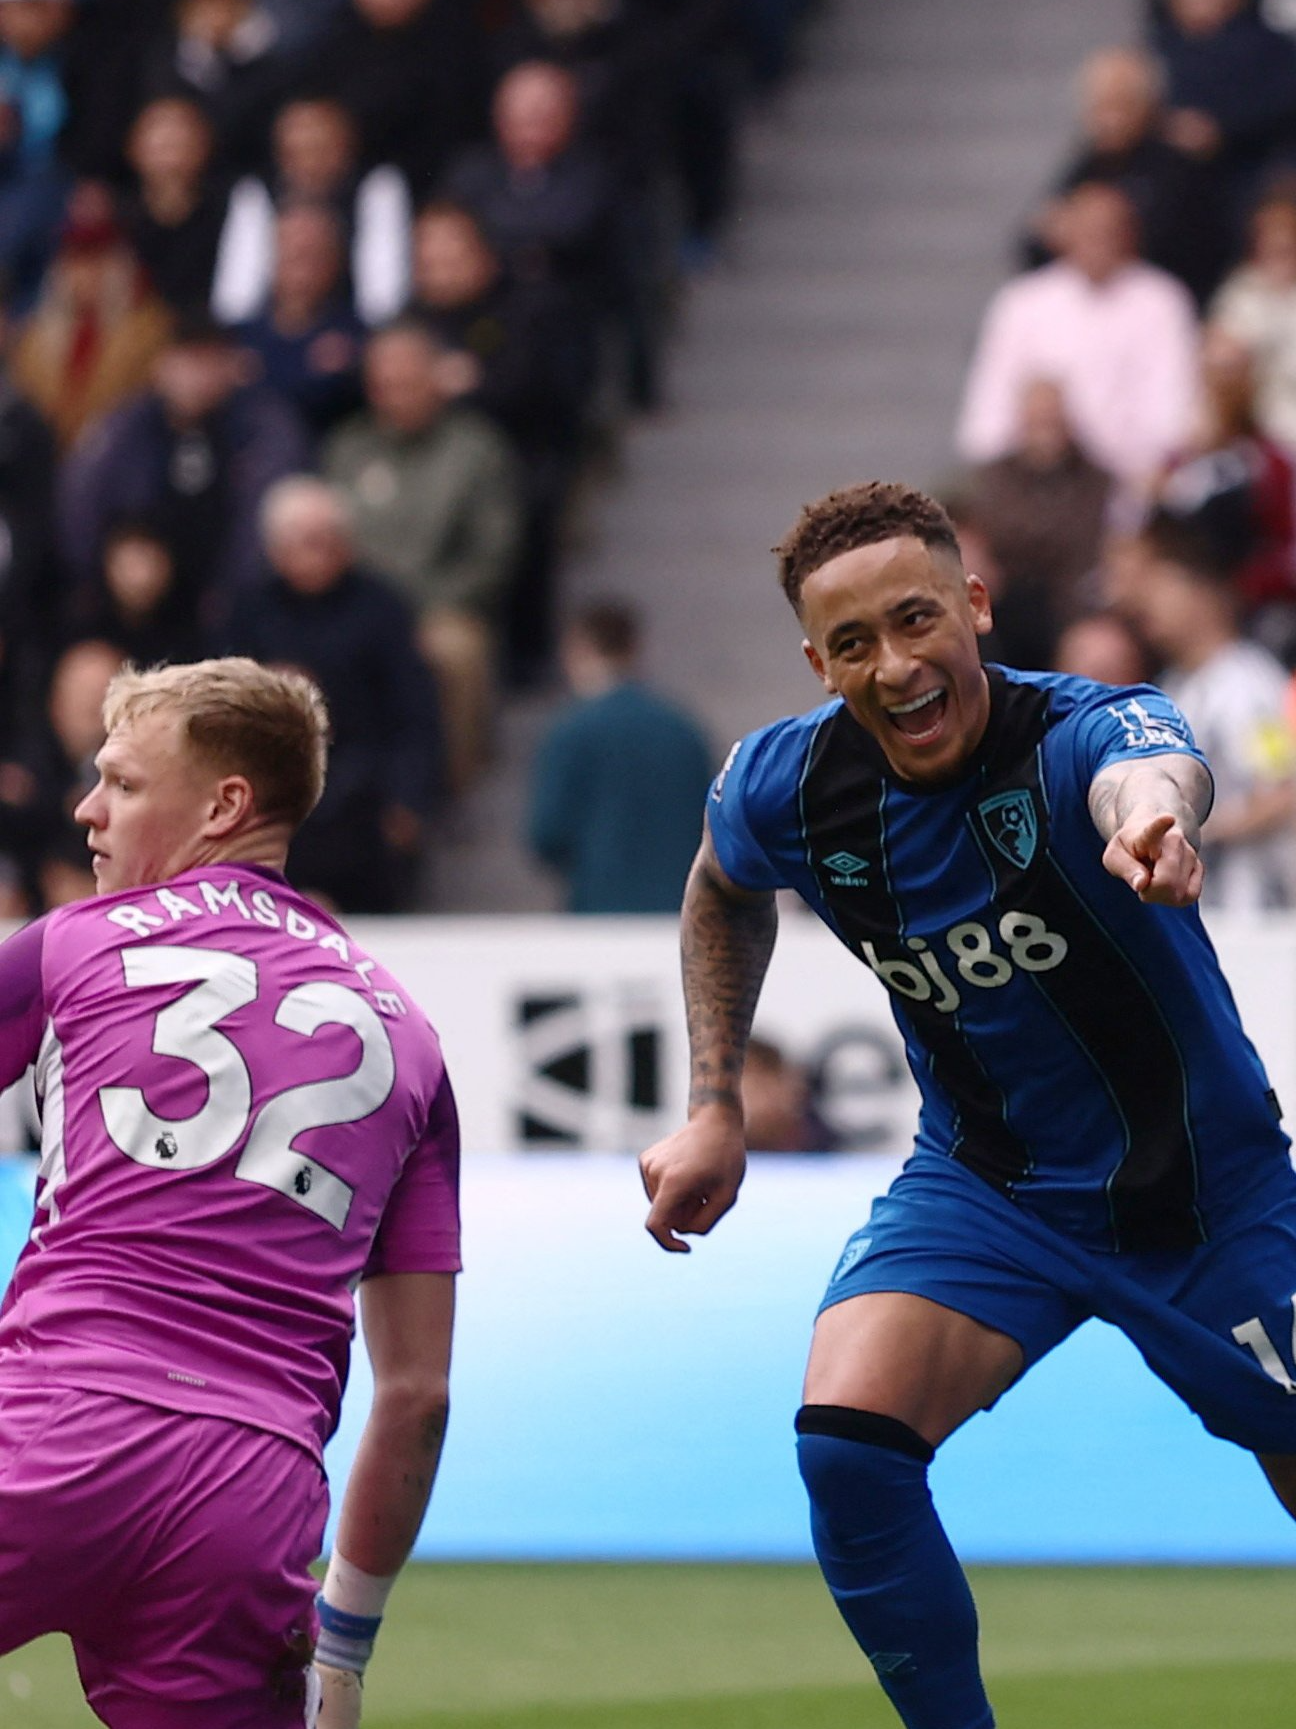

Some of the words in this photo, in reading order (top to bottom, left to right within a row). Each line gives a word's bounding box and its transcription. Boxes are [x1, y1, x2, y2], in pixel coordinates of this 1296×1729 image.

[107, 880, 408, 1017] RAMSDALE
[861, 911, 1069, 1014] bj88
[99, 945, 397, 1233] 32
